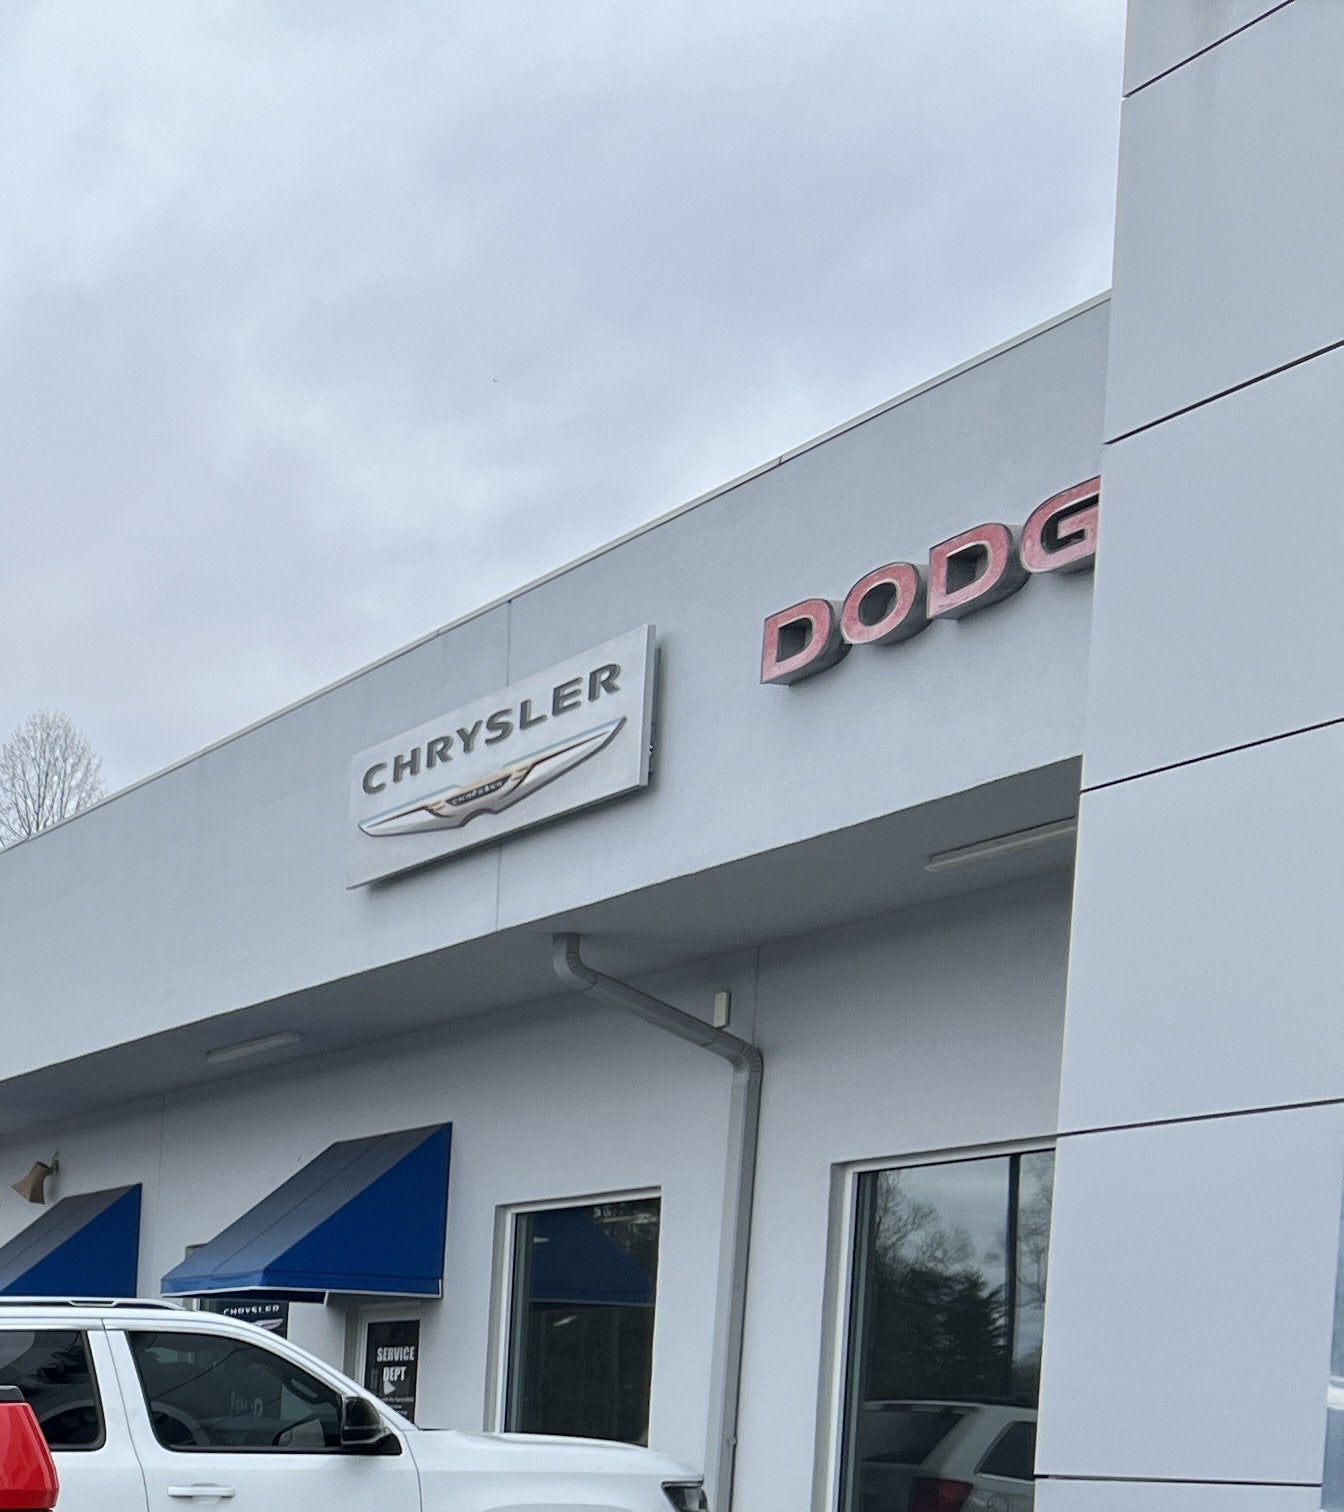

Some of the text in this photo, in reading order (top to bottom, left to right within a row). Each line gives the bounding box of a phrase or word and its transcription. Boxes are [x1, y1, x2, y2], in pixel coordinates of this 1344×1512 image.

[362, 663, 622, 795] CHRYSLER
[376, 1346, 415, 1362] SERVICE
[383, 1366, 406, 1381] DEPT
